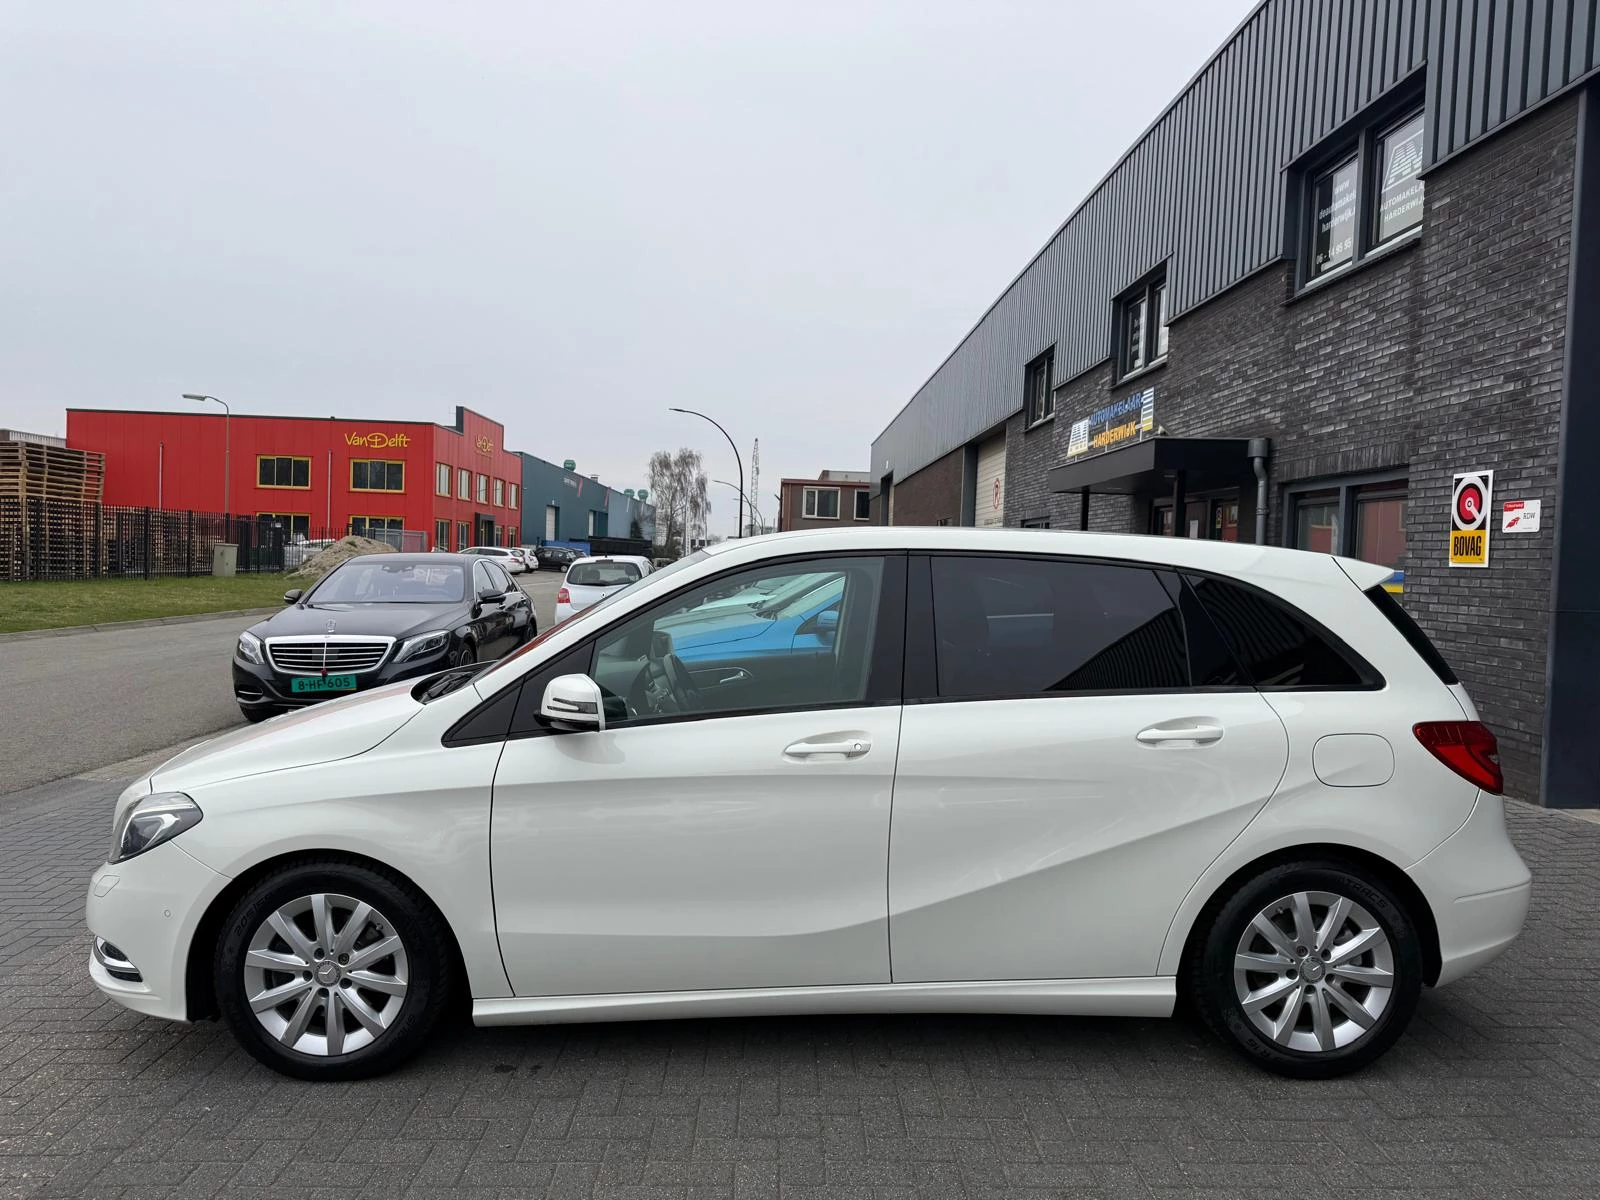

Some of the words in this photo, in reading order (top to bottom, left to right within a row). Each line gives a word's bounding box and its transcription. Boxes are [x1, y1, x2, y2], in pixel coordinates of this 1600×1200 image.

[1090, 392, 1141, 426] AUTOMAKELAAR
[1093, 420, 1136, 448] HARDERWIJK
[1453, 536, 1482, 556] BOVAG
[298, 677, 350, 690] 8-HF605
